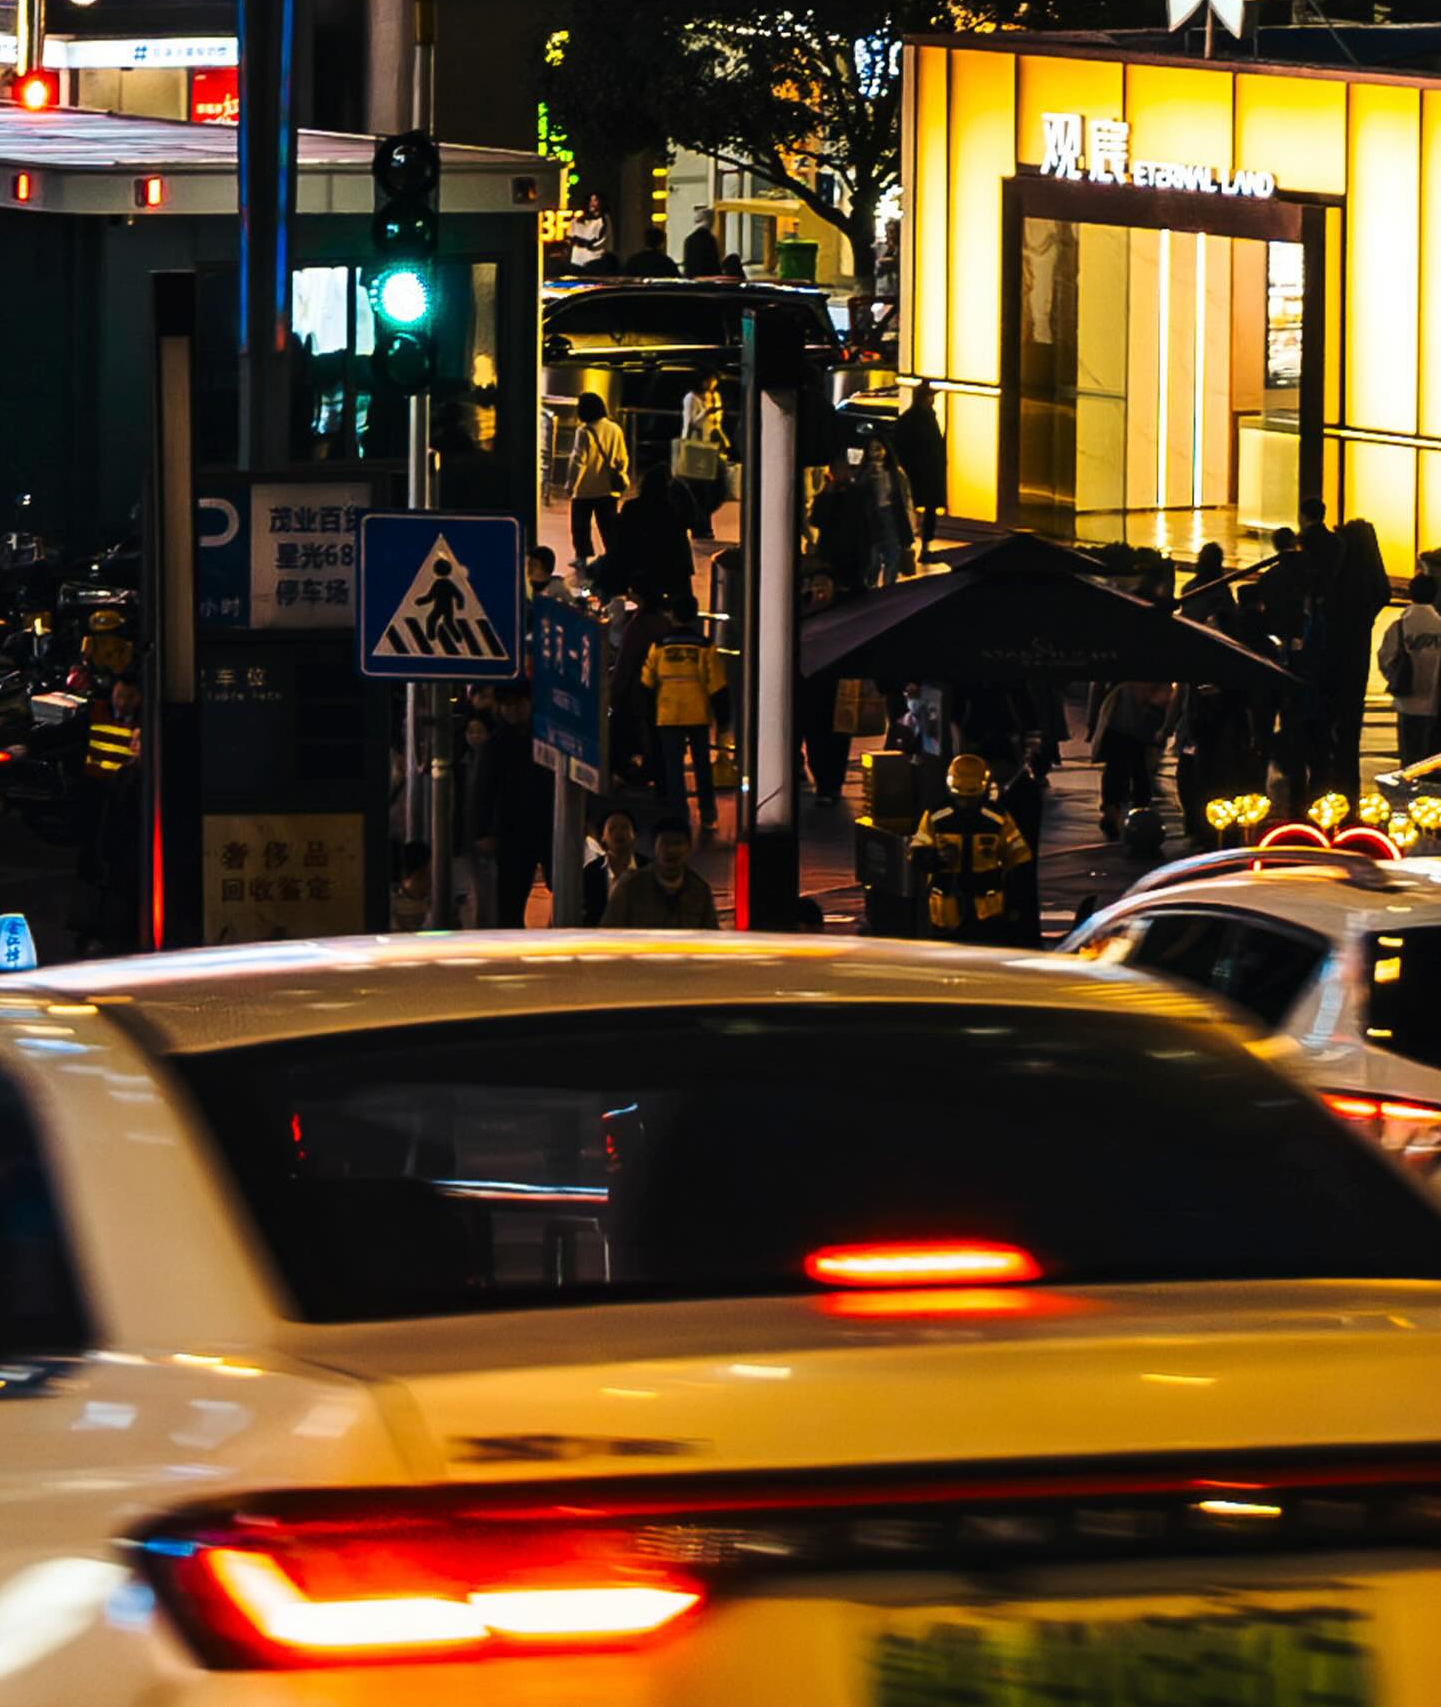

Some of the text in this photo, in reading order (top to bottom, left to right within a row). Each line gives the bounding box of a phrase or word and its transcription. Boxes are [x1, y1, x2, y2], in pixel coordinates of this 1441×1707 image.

[1133, 160, 1276, 199] ETERNAL LAND
[275, 578, 350, 607] 停车场
